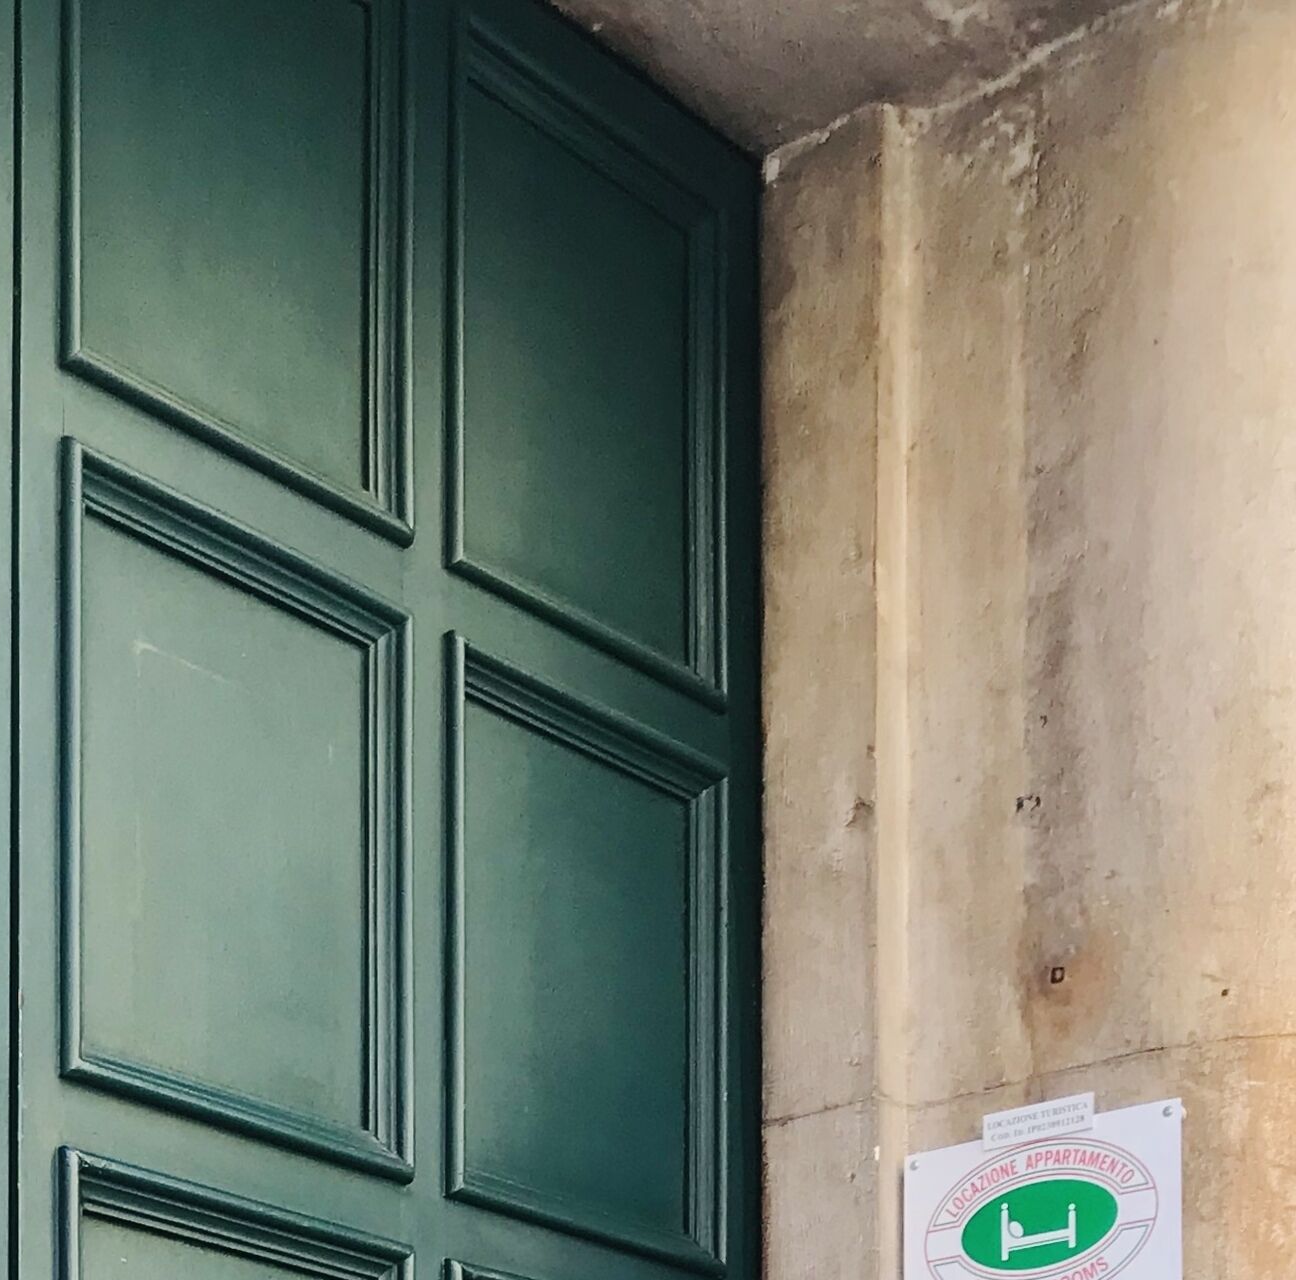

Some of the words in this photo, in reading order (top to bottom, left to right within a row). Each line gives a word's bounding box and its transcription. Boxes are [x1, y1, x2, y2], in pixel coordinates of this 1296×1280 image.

[987, 1112, 1039, 1130] LOCAZIONE
[1041, 1102, 1088, 1118] TURISTICA
[945, 1159, 1019, 1218] LOCAZIONE
[1025, 1148, 1136, 1185] APPARTAMENTO
